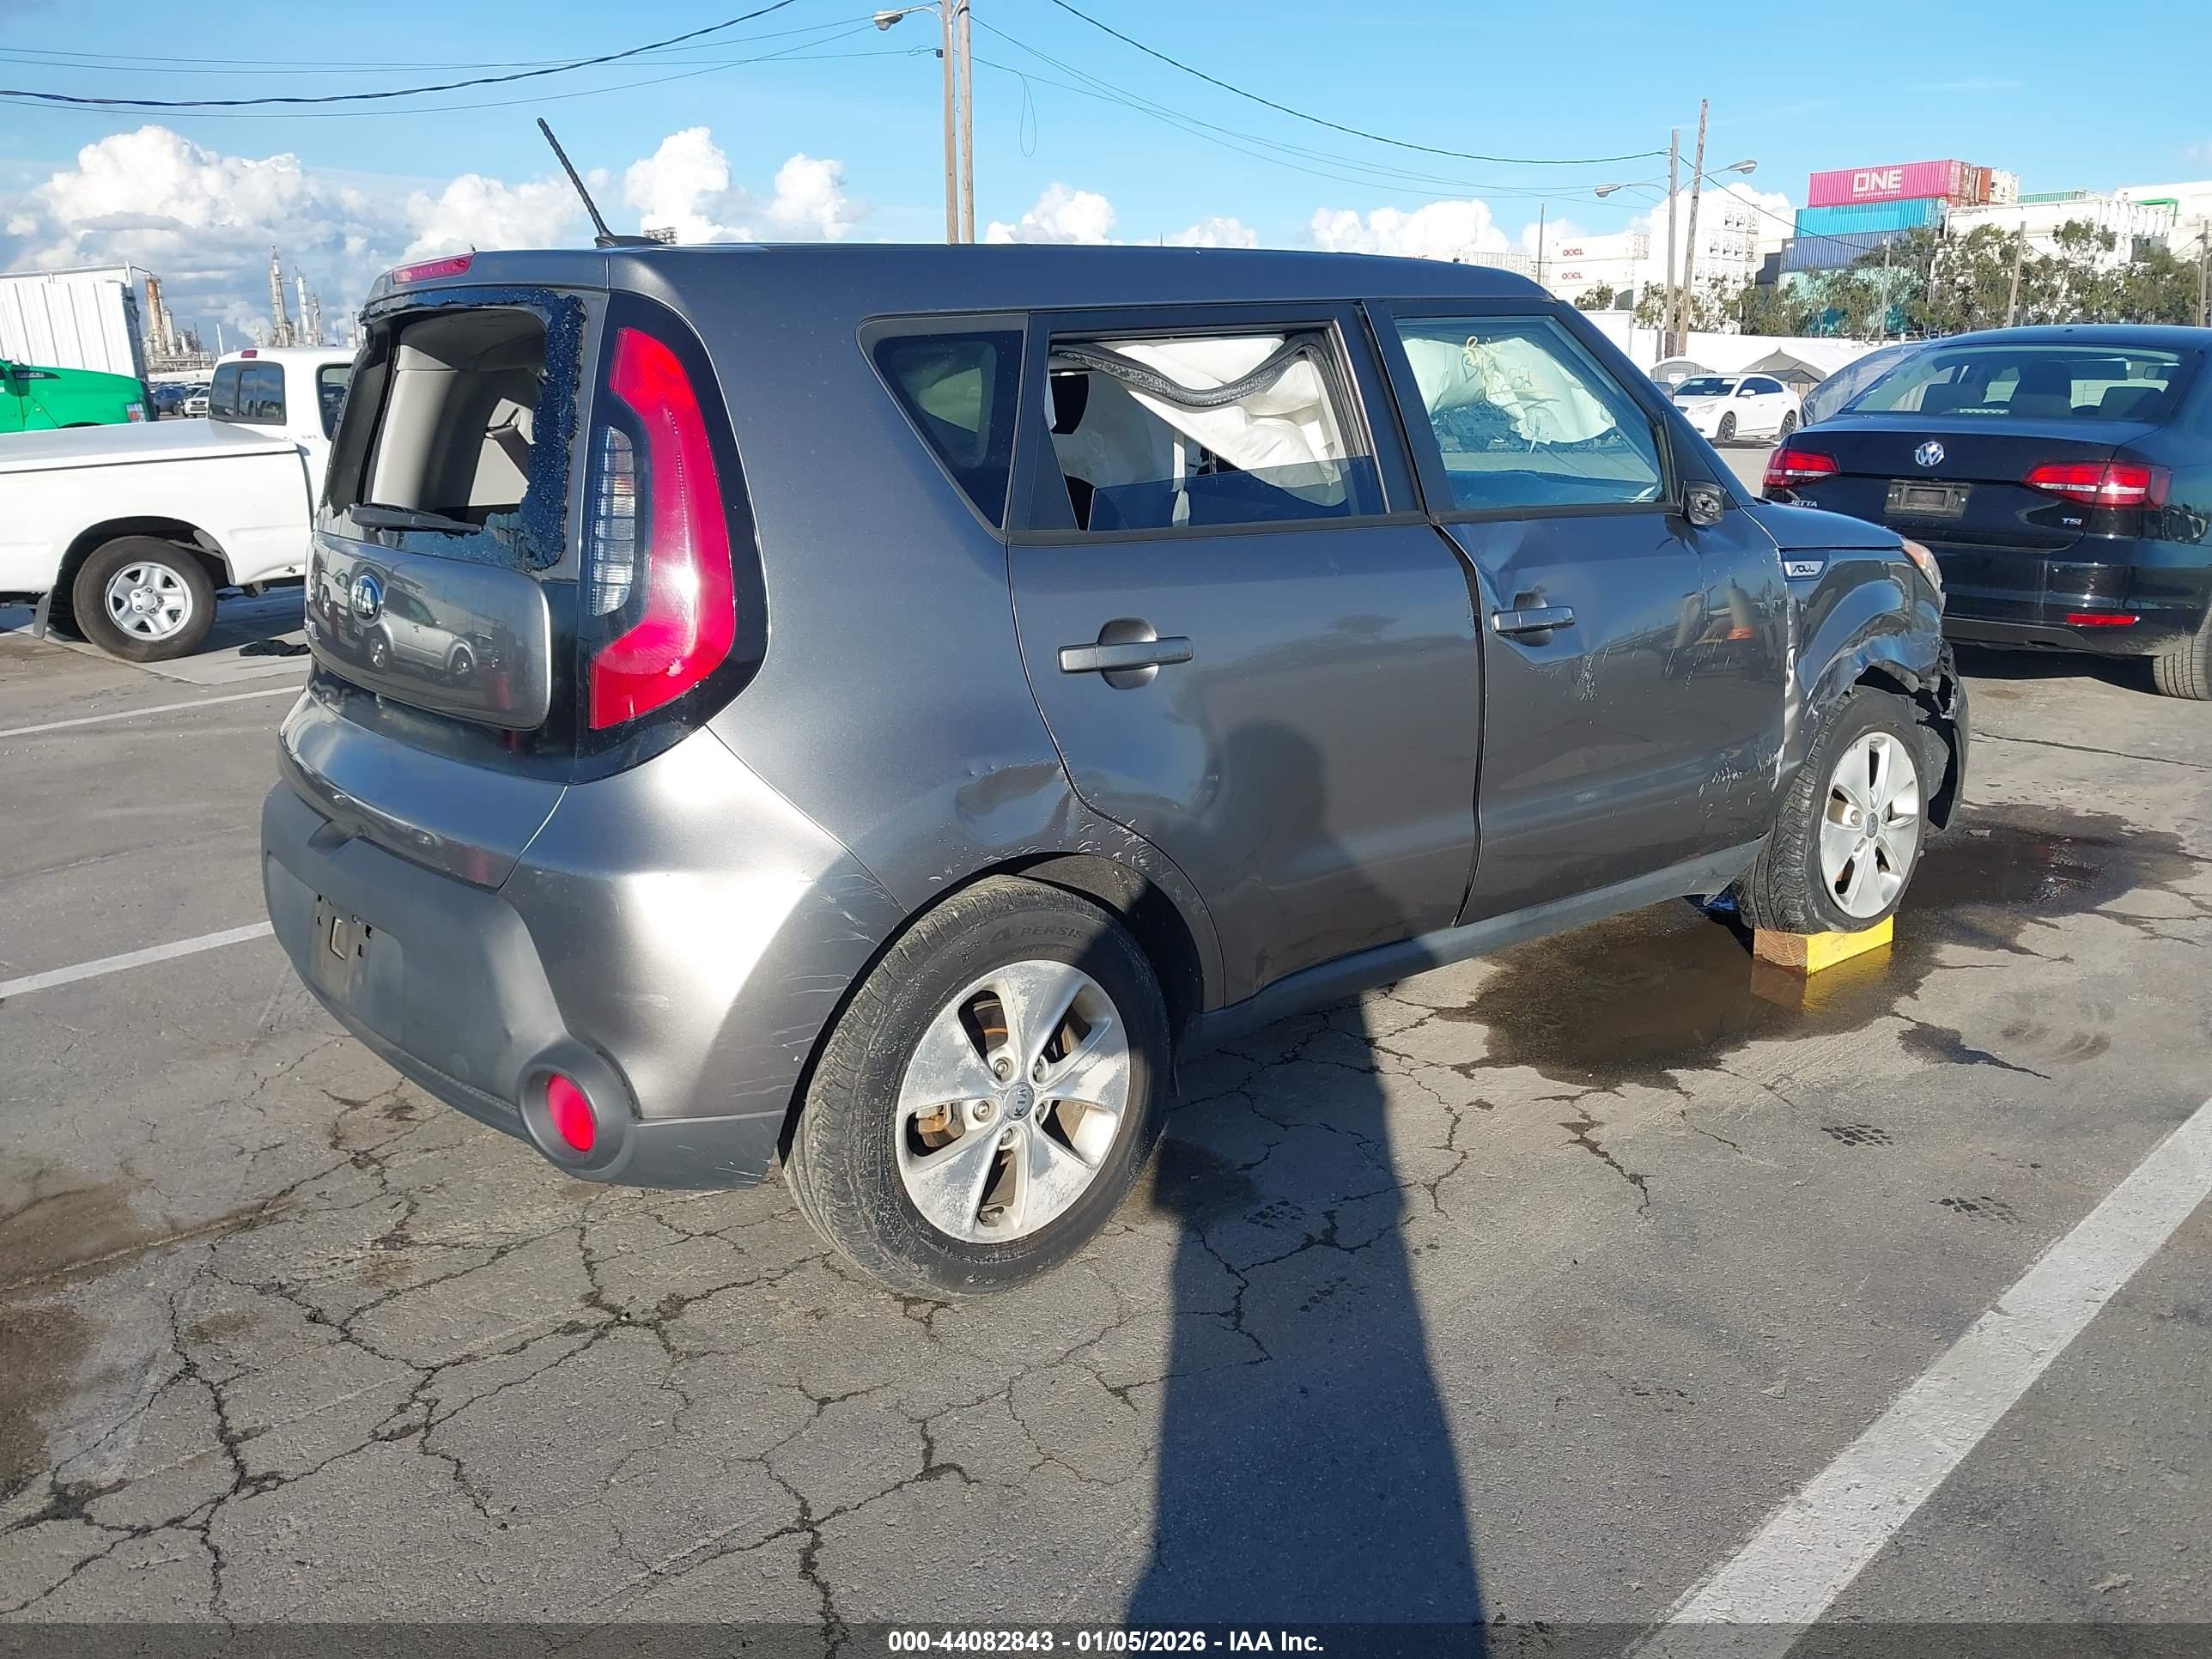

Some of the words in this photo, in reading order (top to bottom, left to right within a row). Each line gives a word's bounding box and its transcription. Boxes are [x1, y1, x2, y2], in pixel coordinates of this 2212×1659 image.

[1853, 169, 1903, 193] ONE
[1563, 248, 1584, 257] OOCL
[1561, 271, 1583, 280] OOCL
[1019, 925, 1092, 943] PERSIS
[1013, 1088, 1027, 1116] KIA
